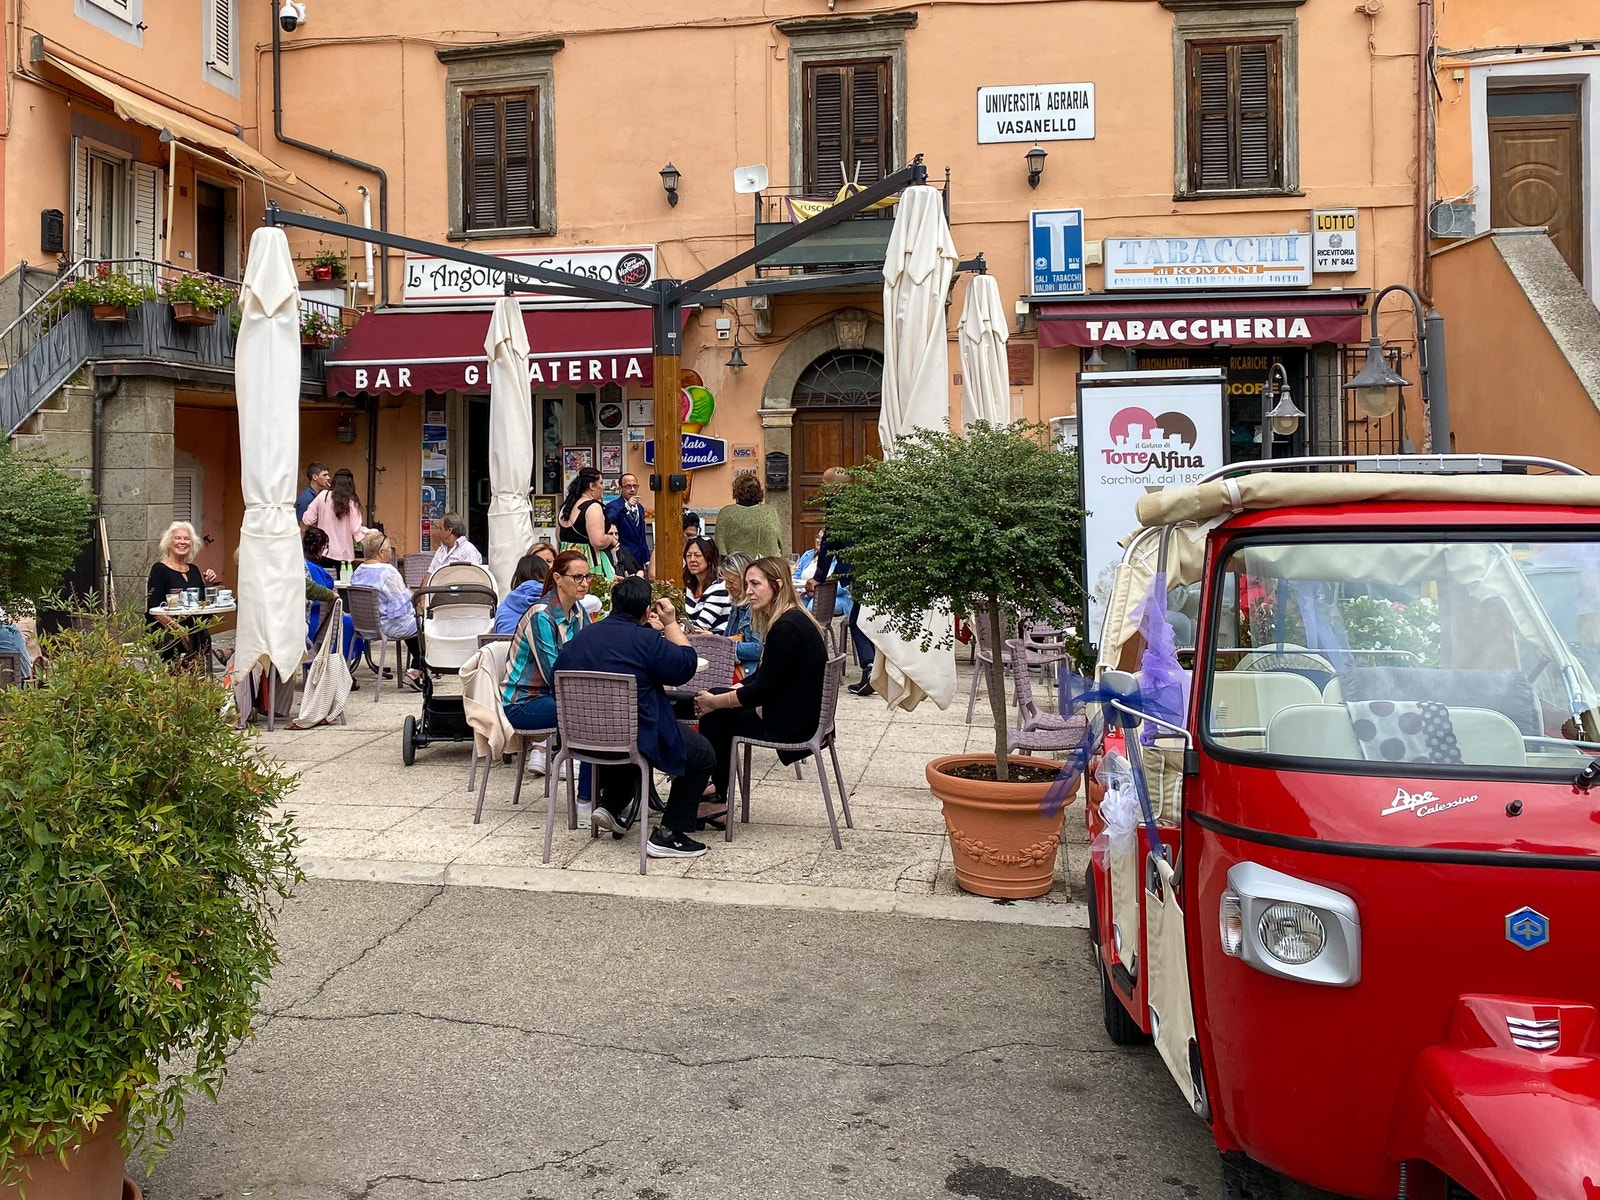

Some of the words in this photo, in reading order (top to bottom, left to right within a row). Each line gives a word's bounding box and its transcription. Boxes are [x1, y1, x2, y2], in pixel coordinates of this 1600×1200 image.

[1047, 90, 1089, 111] AGRARIA
[997, 118, 1076, 134] VASANELLO
[1318, 214, 1355, 230] LOTTO
[1119, 237, 1299, 265] TABACCHI
[1316, 249, 1355, 257] RICEVITORIA
[1318, 258, 1328, 266] VT
[1341, 257, 1354, 266] 842
[1156, 267, 1169, 275] di
[1173, 266, 1258, 275] ROMANI
[1035, 275, 1048, 283] SALI
[1052, 273, 1081, 283] TABACCHI
[1035, 284, 1055, 292] VALORI
[1059, 283, 1081, 291] BOLLATI
[1086, 318, 1312, 341] TABACCHERIA
[1230, 356, 1268, 370] RICARICHE
[355, 367, 412, 389] BAR
[465, 357, 643, 385] GATERIA
[682, 436, 706, 449] elato
[1164, 441, 1171, 449] di
[1100, 475, 1154, 485] Sarchioni,
[1157, 474, 1176, 483] dal
[1386, 787, 1440, 814] Ape
[1416, 795, 1478, 818] Calessino
